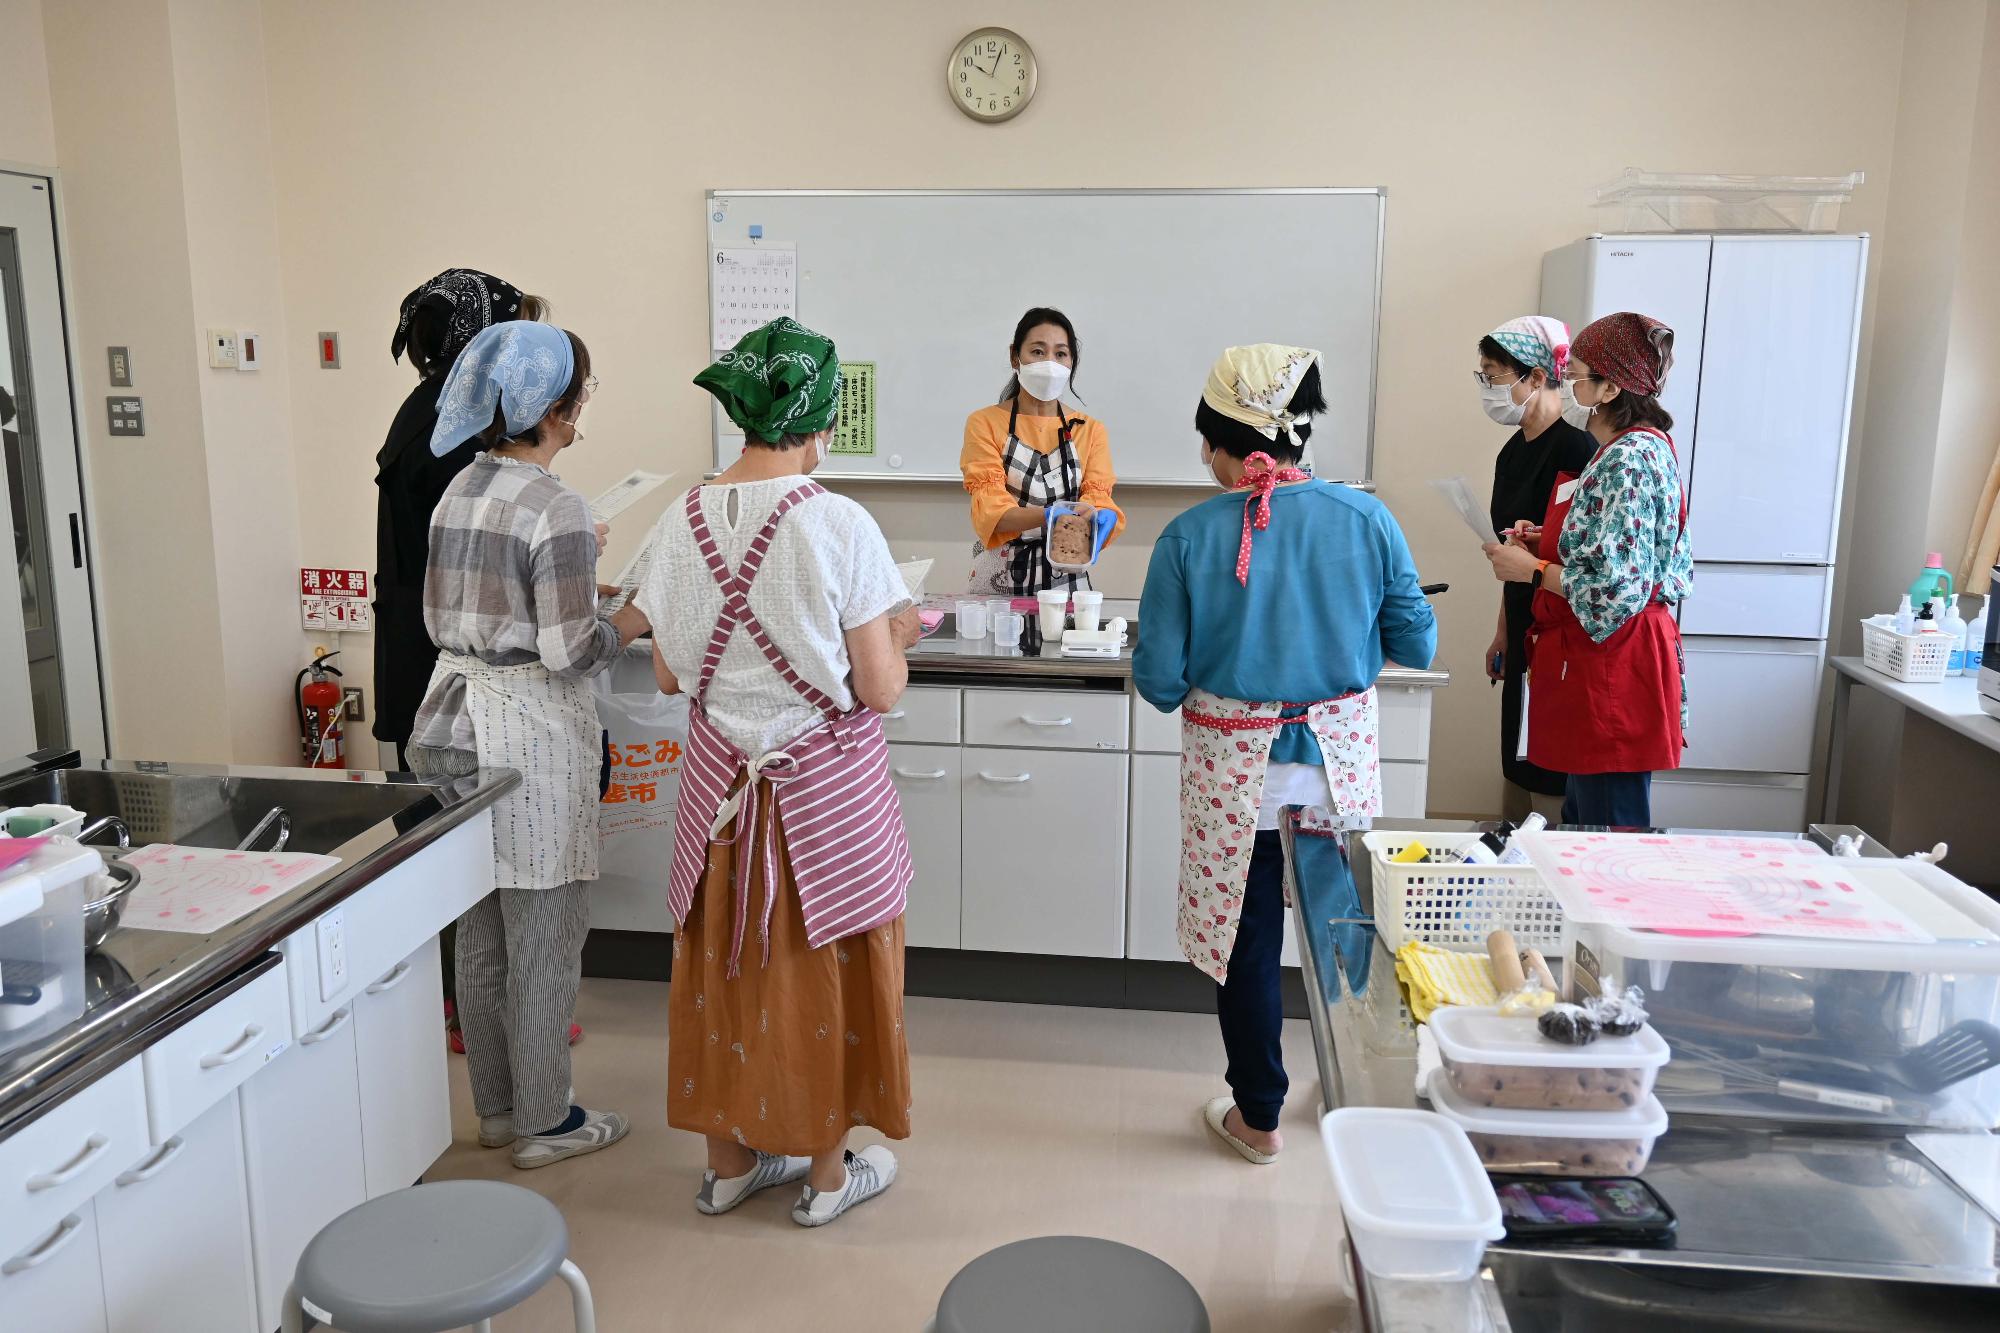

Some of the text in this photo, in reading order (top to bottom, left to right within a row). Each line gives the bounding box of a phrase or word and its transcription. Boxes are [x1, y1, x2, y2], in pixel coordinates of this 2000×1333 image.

[974, 45, 982, 55] 11
[987, 41, 996, 52] 12
[1004, 43, 1007, 55] 1
[964, 56, 973, 67] 10
[1013, 54, 1021, 65] 2
[960, 72, 967, 83] 9
[1018, 69, 1025, 80] 3
[965, 87, 972, 97] 8
[1013, 85, 1020, 96] 4
[976, 98, 982, 108] 7
[989, 100, 997, 111] 6
[1003, 96, 1011, 107] 5
[717, 252, 724, 265] 6
[303, 570, 365, 590] 消火器
